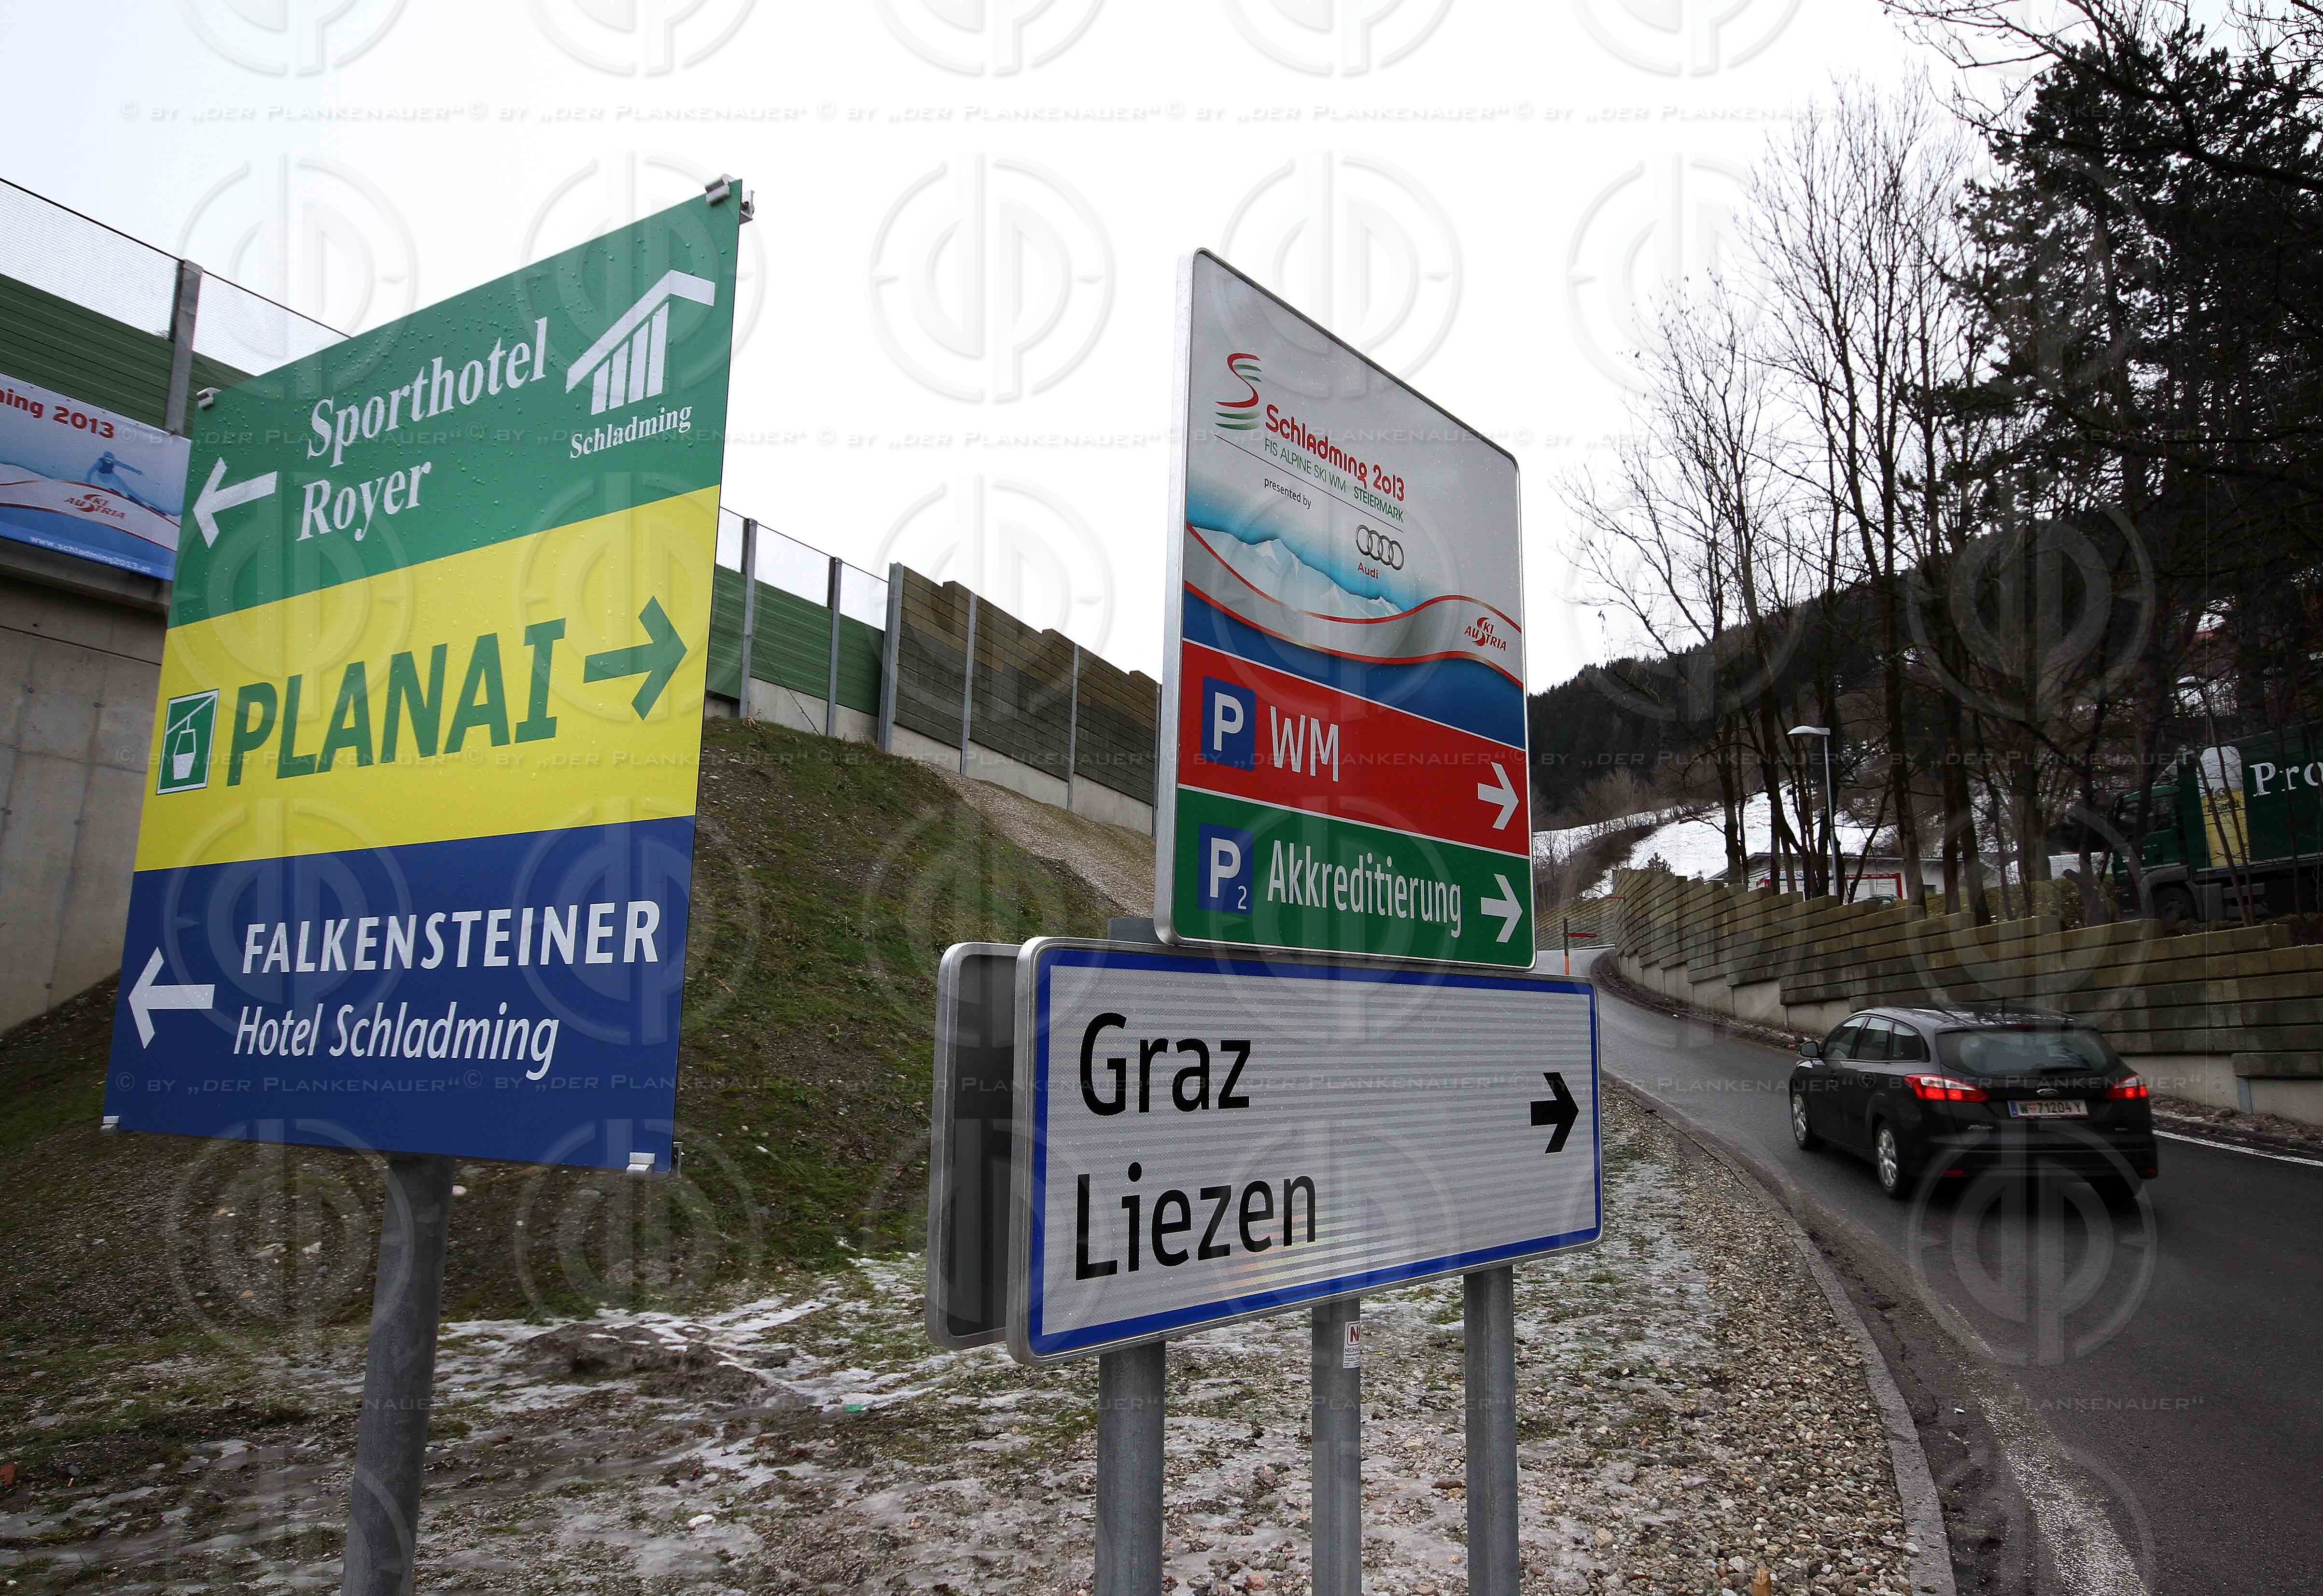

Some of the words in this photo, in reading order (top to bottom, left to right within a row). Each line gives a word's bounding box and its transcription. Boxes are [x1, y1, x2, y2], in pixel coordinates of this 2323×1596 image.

[53, 406, 114, 439] 2013
[307, 317, 547, 467] Sporthotel
[570, 406, 692, 459] Schladming
[1265, 438, 1278, 457] FIS
[1280, 447, 1312, 475] ALPINE
[1314, 464, 1327, 483] SKI
[1329, 471, 1346, 493] WM
[1353, 486, 1404, 523] STEIERMARK
[1266, 404, 1368, 490] Schladming
[296, 462, 432, 541] Royer
[1264, 477, 1301, 503] presented
[1303, 494, 1312, 510] by
[1357, 562, 1379, 579] Audi
[227, 618, 566, 787] PLANAI
[1213, 691, 1244, 752] P
[1270, 705, 1339, 783] WM
[1267, 840, 1461, 938] Akkreditierung
[242, 900, 660, 974] FALKENSTEINER
[233, 1003, 323, 1056] Hotel
[329, 1001, 559, 1080] Schladming
[1079, 1012, 1251, 1116] Graz
[1076, 1162, 1315, 1281] Liezen
